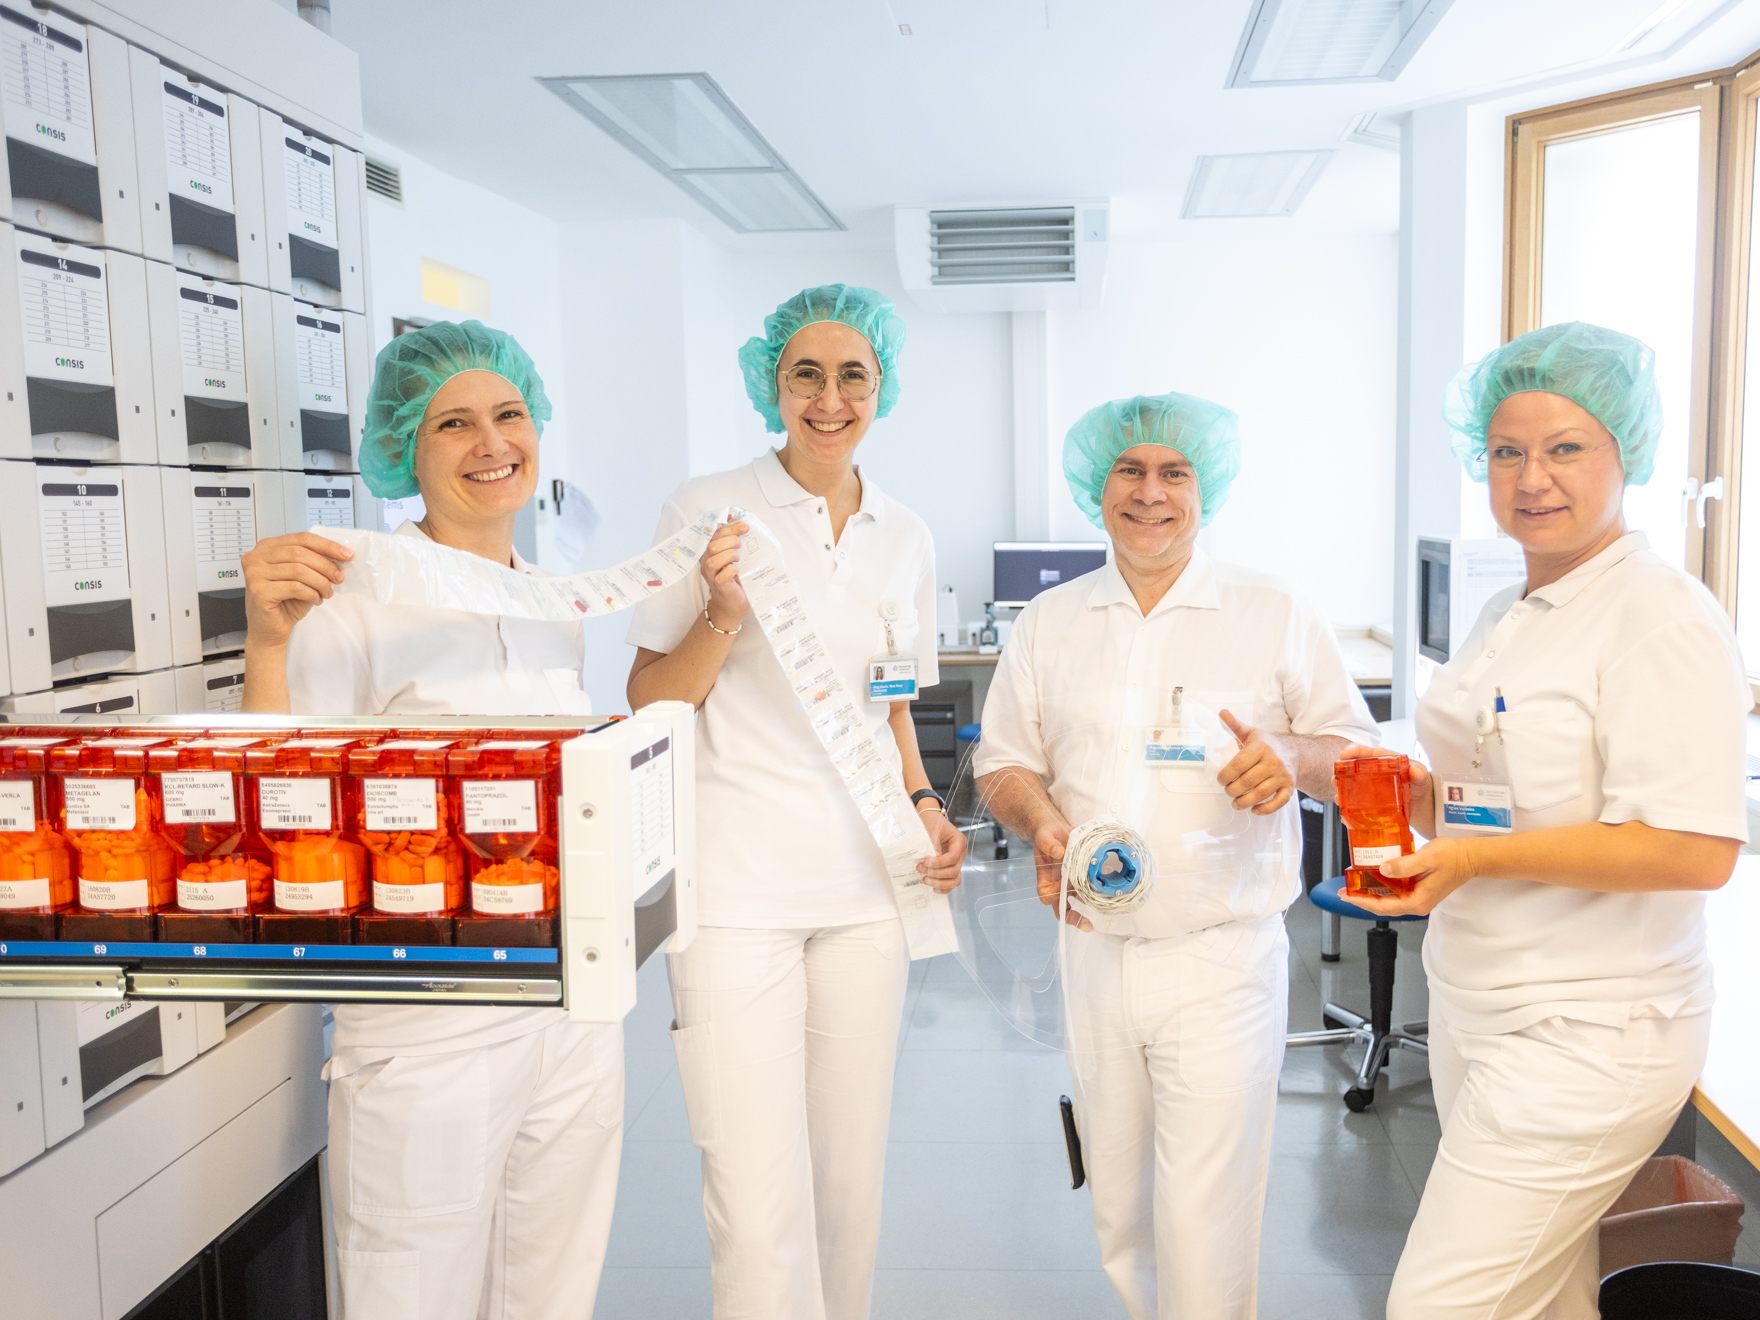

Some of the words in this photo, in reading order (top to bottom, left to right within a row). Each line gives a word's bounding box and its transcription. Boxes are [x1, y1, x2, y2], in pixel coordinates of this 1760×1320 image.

[37, 23, 48, 36] 18
[191, 94, 200, 106] 19
[58, 259, 68, 270] 14
[206, 294, 214, 304] 15
[77, 485, 87, 495] 10
[220, 488, 227, 496] 11
[327, 489, 333, 497] 12
[232, 675, 238, 684] 7
[96, 702, 101, 713] 6
[94, 944, 107, 954] 69
[194, 945, 207, 955] 68
[293, 947, 306, 957] 67
[393, 948, 406, 958] 66
[493, 950, 507, 959] 65
